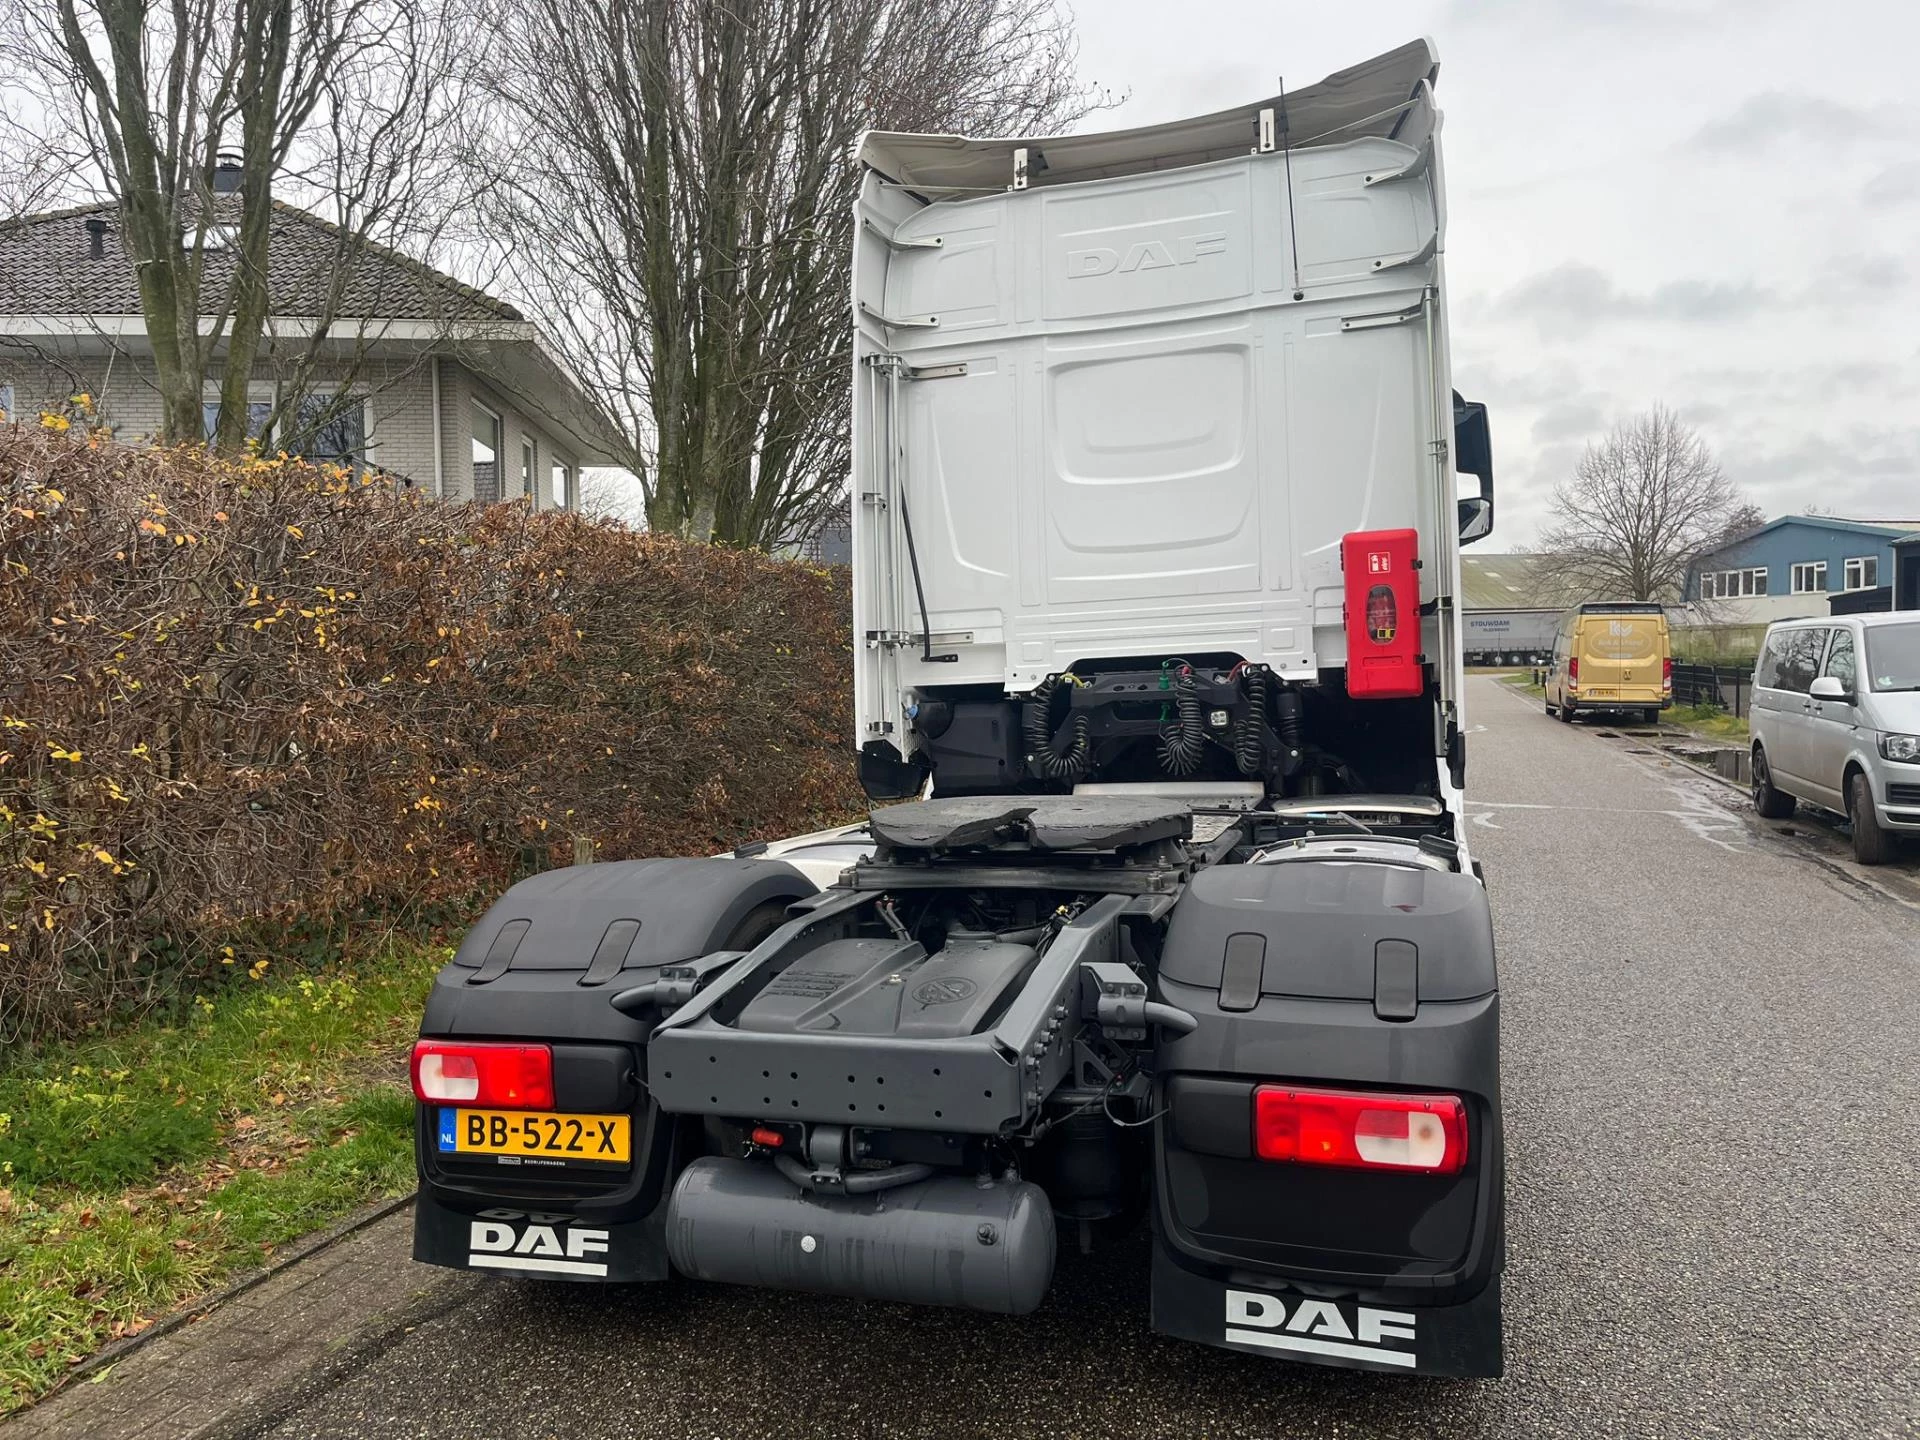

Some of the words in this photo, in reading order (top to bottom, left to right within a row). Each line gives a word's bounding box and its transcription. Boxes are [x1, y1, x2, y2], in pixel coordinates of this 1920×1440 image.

[1067, 230, 1227, 279] DAF
[441, 1134, 454, 1144] NL
[467, 1115, 616, 1153] BB-522-X
[470, 1221, 609, 1257] DAF
[1226, 1290, 1416, 1343] DAF
